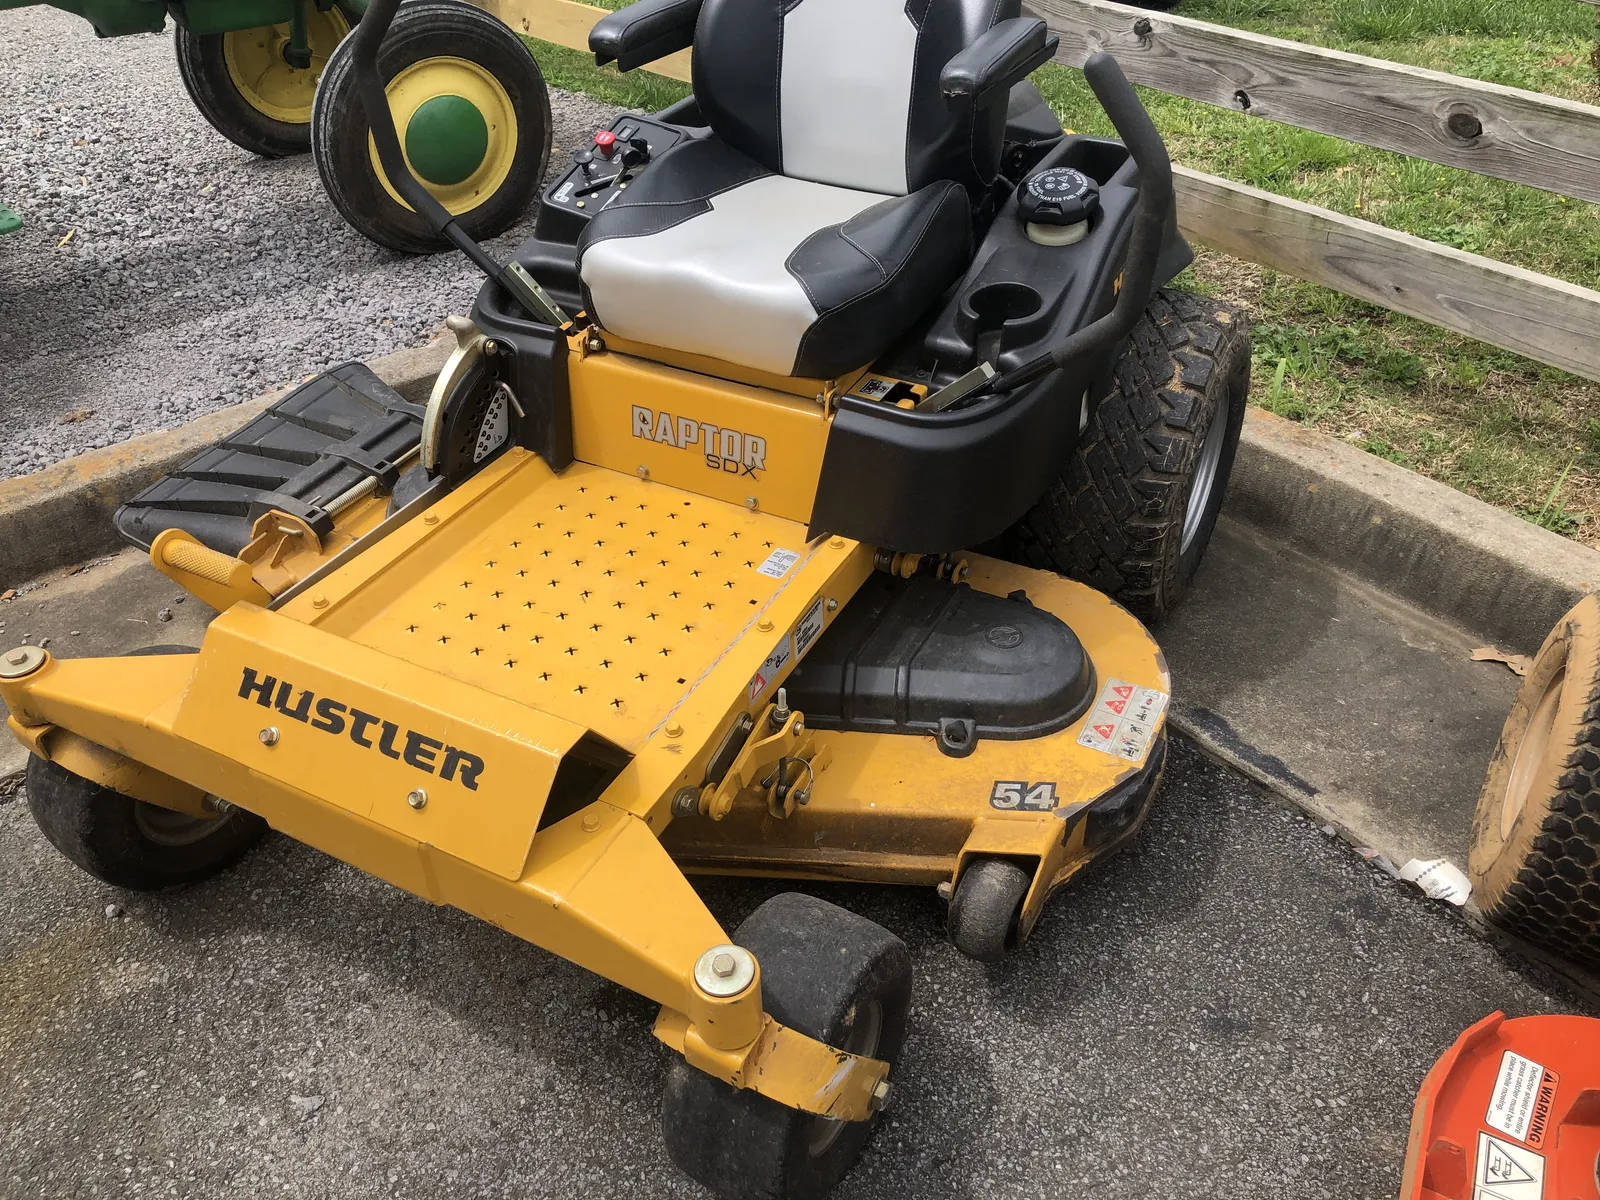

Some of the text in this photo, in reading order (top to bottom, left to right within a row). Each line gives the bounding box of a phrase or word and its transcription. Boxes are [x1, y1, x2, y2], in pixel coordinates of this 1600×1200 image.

[632, 404, 766, 471] RAPTOR
[706, 454, 757, 480] SDX
[238, 666, 484, 791] HUSTLER
[991, 782, 1057, 810] 54
[1508, 1056, 1517, 1072] place
[1519, 1060, 1527, 1077] grass
[1504, 1072, 1513, 1087] while
[1512, 1077, 1523, 1100] catcher
[1526, 1066, 1538, 1092] Deflector
[1508, 1098, 1517, 1114] must
[1521, 1091, 1531, 1110] shield
[1506, 1114, 1513, 1122] be
[1515, 1116, 1524, 1134] entire
[1529, 1086, 1552, 1143] WARNING
